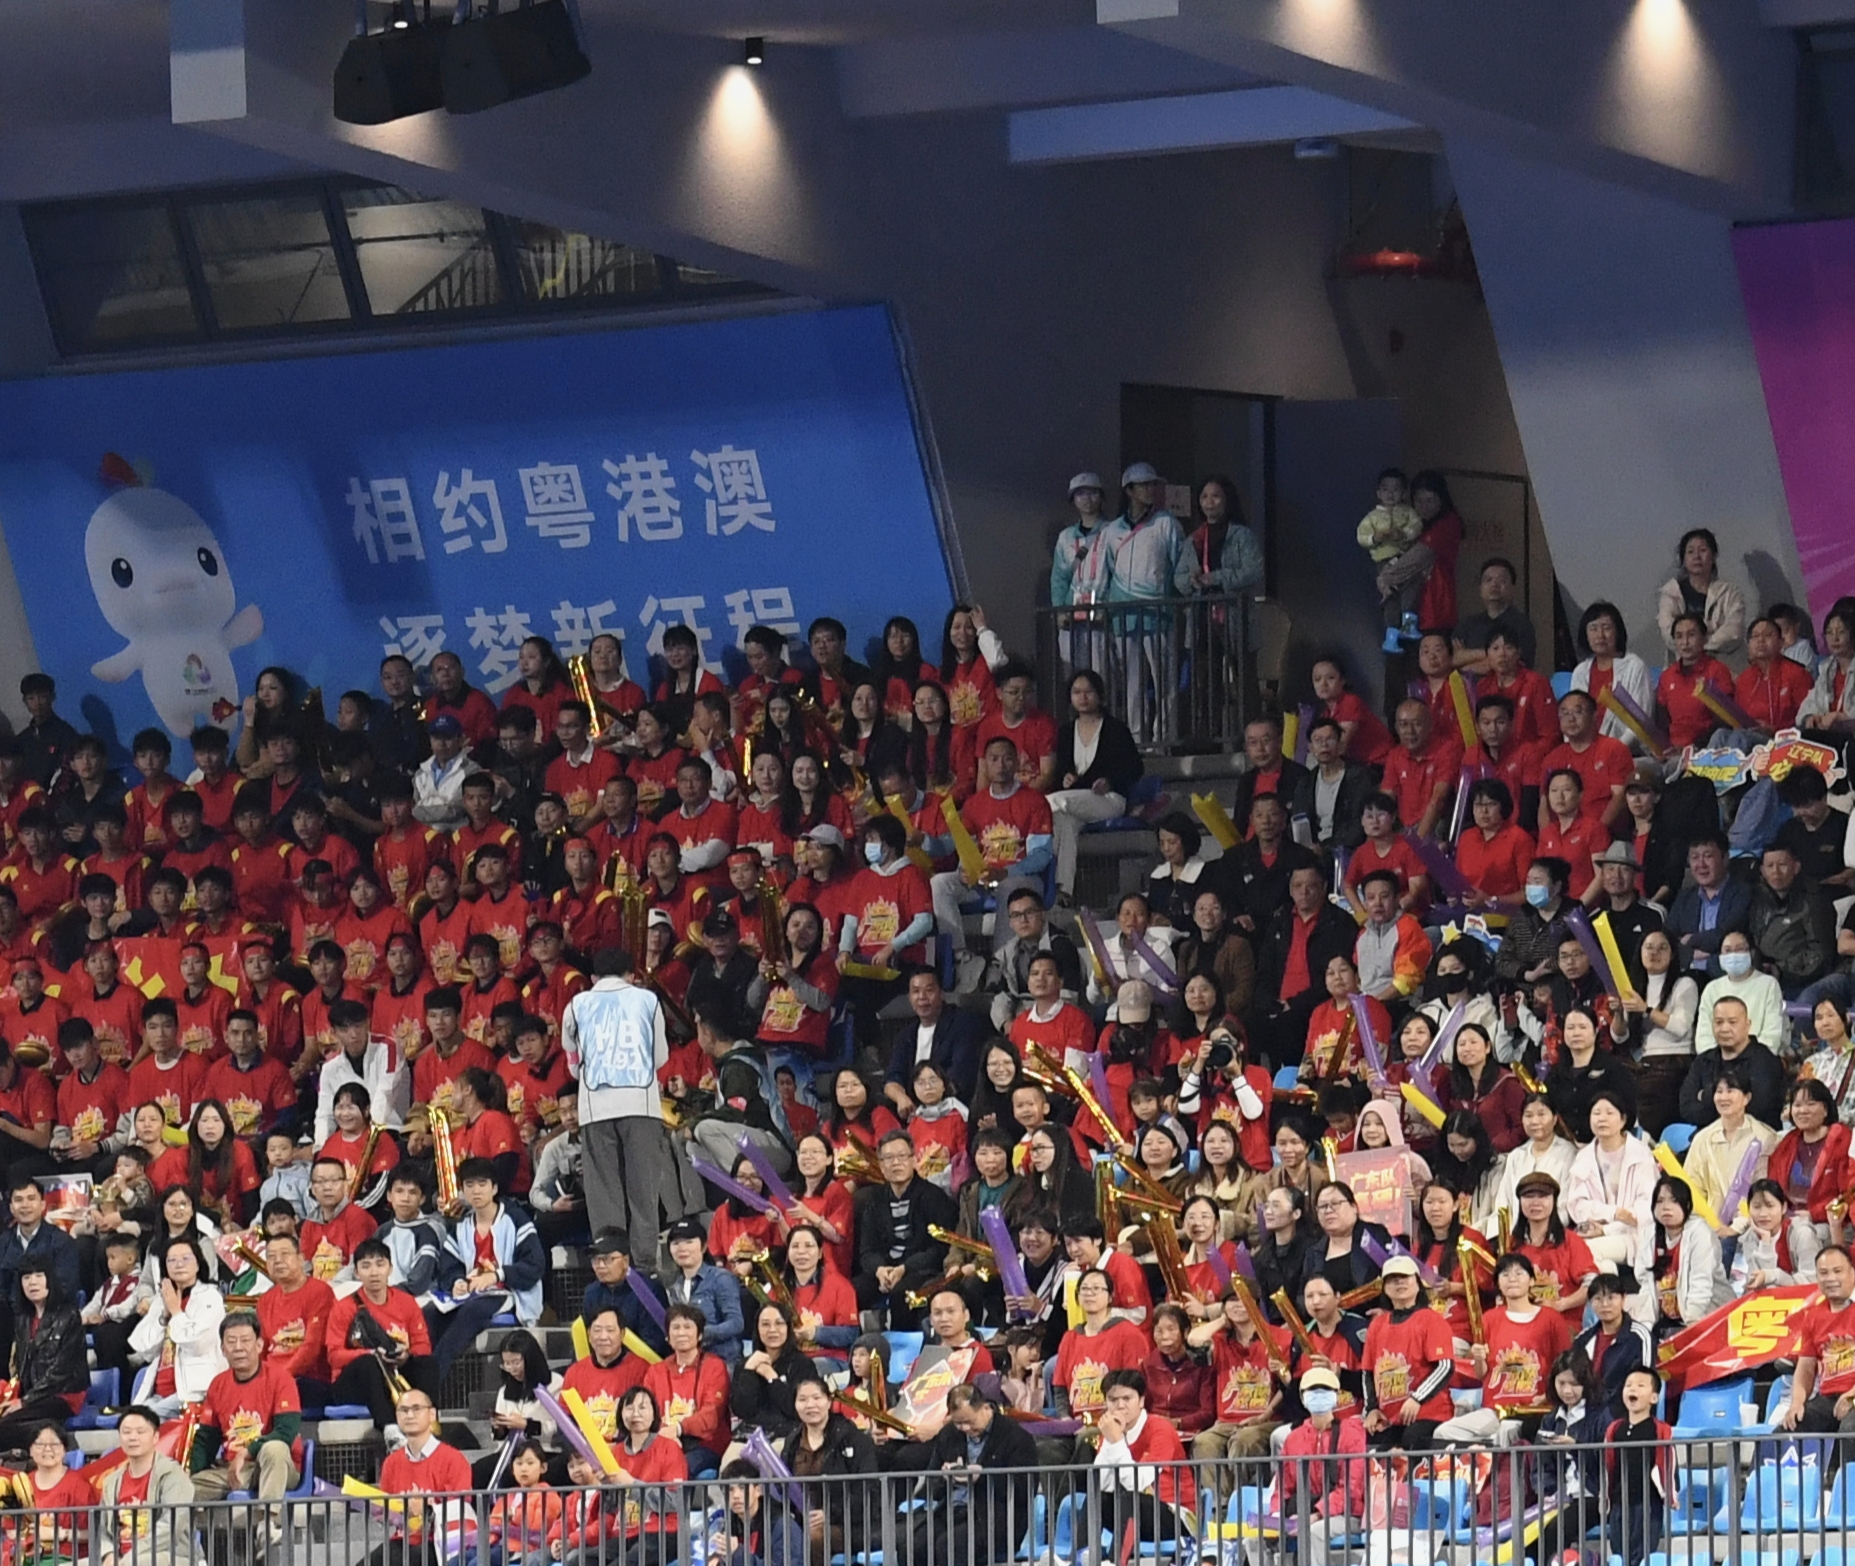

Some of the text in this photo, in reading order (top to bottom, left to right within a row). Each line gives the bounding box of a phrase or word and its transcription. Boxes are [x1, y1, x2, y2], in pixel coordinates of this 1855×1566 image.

[346, 444, 776, 564] 相约粤港澳
